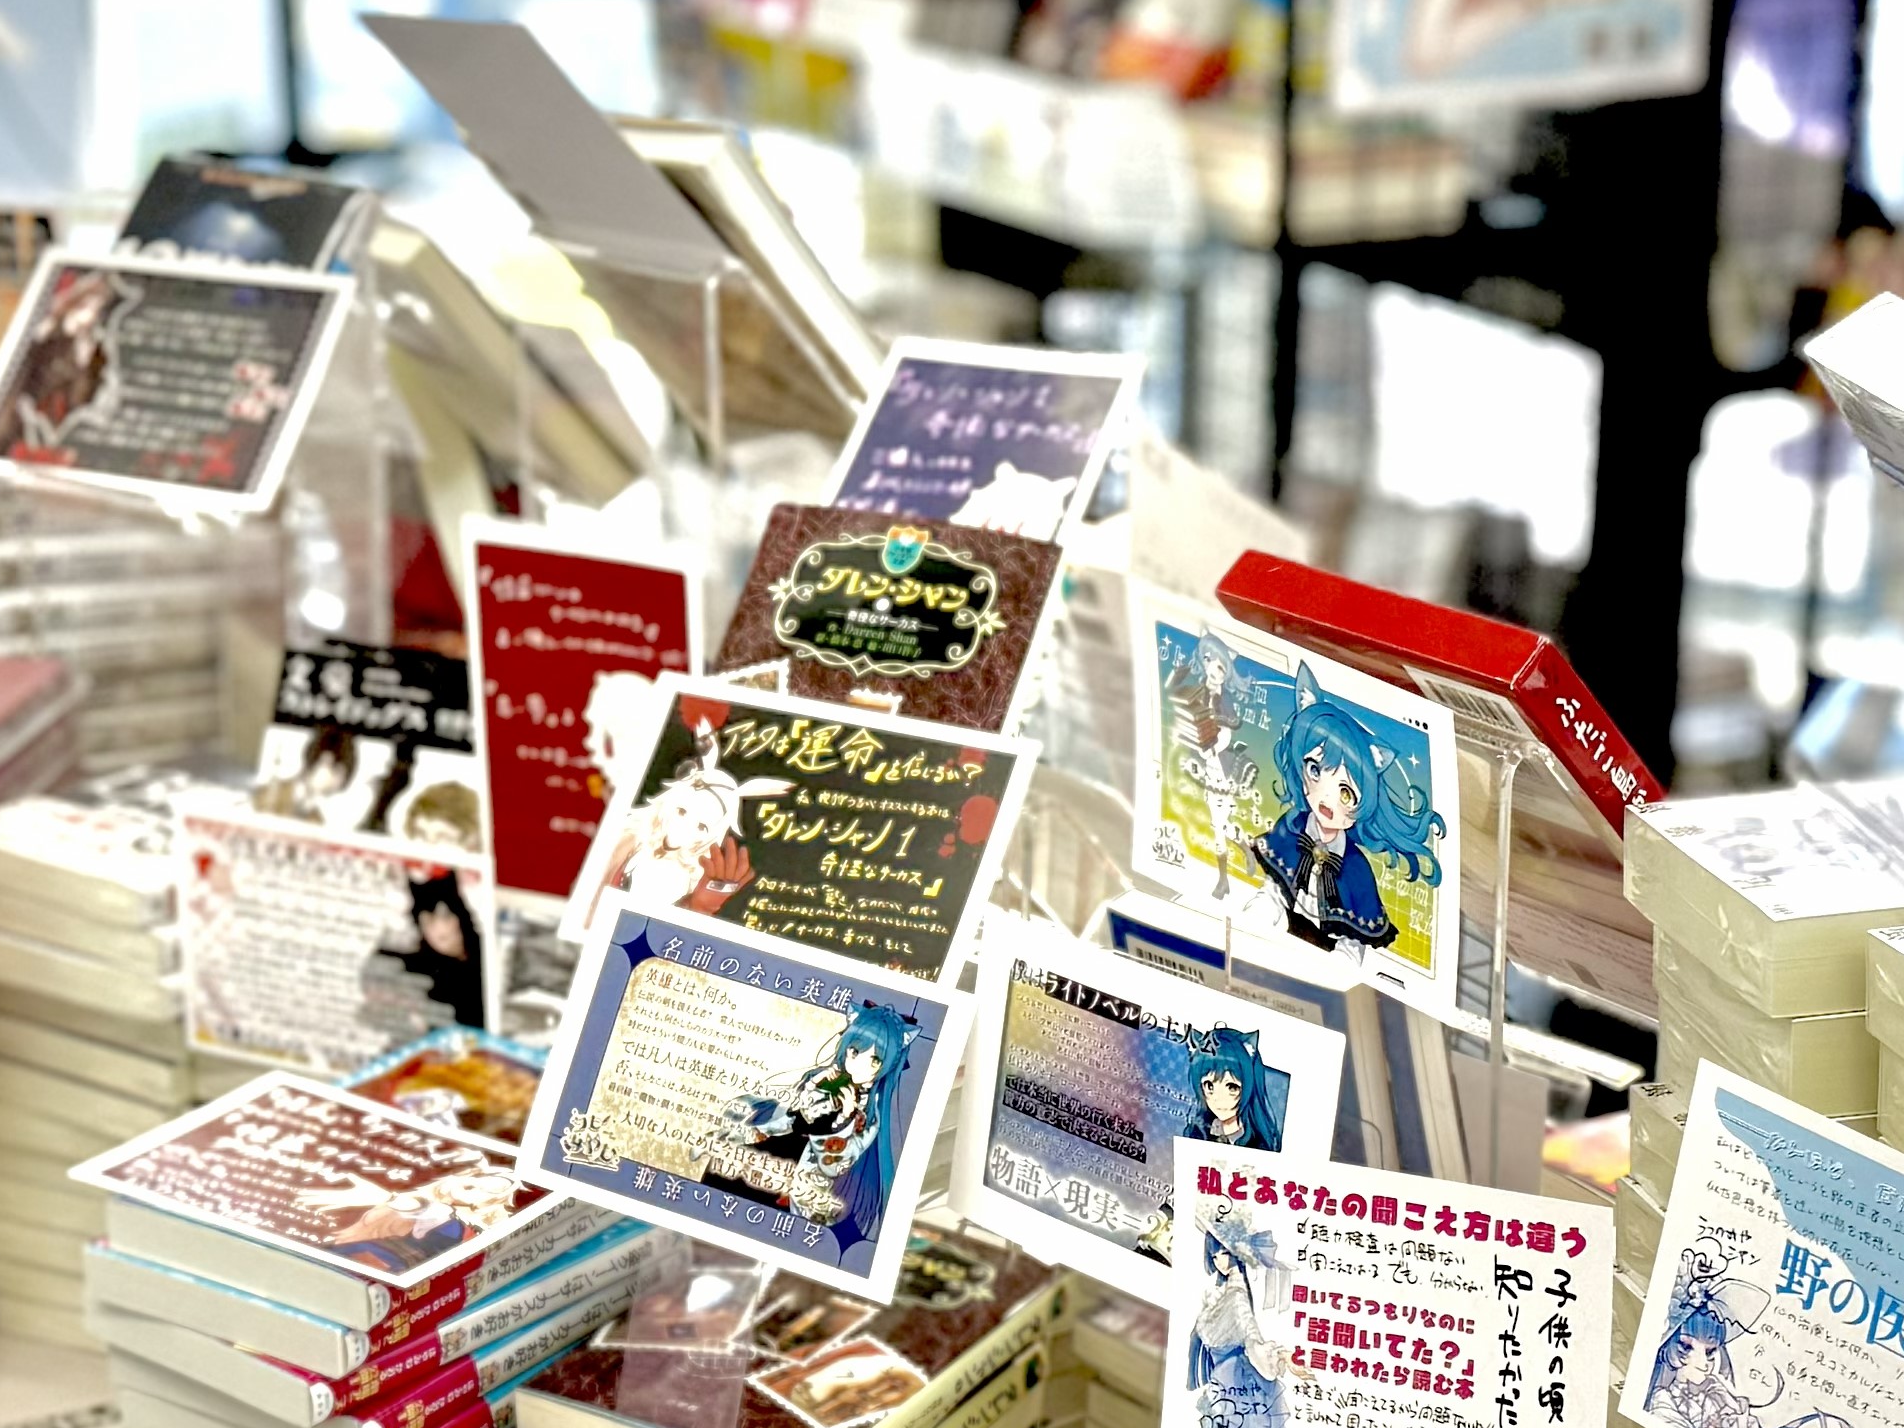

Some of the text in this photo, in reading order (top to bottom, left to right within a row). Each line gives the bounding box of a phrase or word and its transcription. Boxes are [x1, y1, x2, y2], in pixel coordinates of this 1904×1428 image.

[645, 967, 738, 1012] 英雄とは、何か。
[661, 934, 854, 1012] 名前のない英雄
[1197, 1165, 1589, 1260] 私とあなたの聞こえ方は違う
[1291, 1283, 1476, 1336] 聞いてるつもりなのに
[1290, 1344, 1476, 1402] と言われたら読む本
